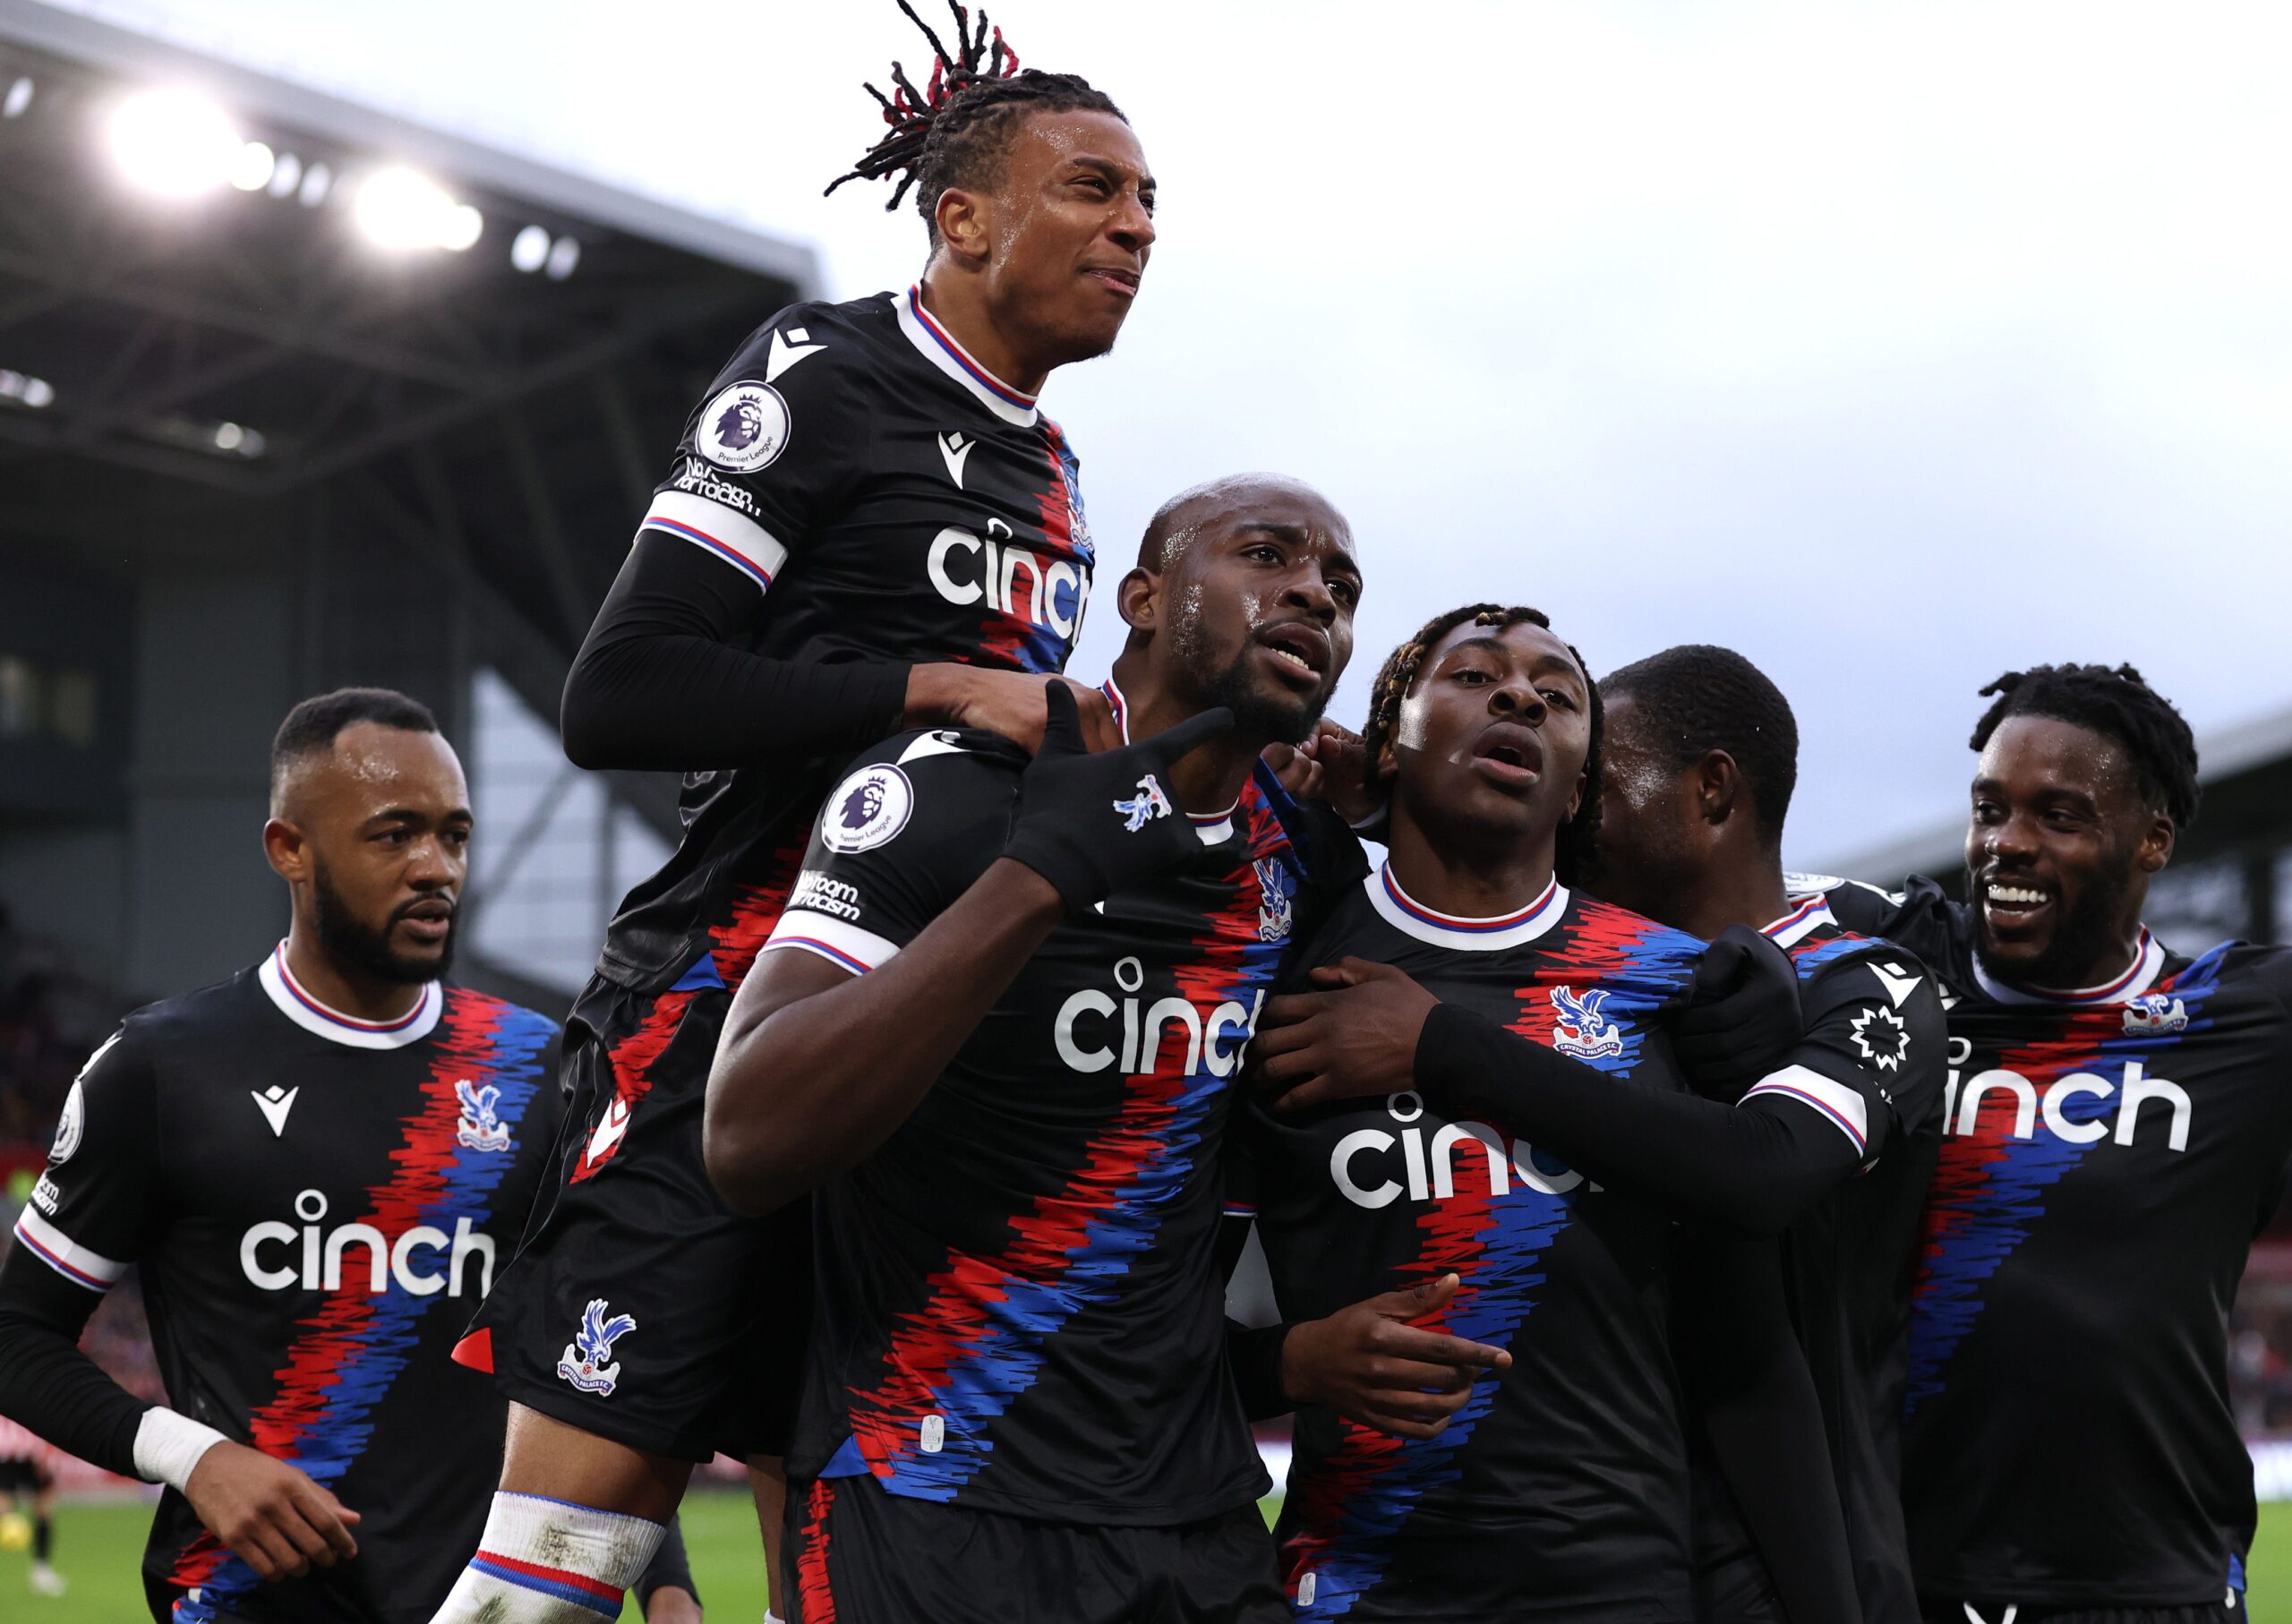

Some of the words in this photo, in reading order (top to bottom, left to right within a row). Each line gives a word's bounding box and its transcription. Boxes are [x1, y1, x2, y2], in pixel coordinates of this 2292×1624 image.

[718, 451, 748, 463] Premier
[749, 436, 774, 460] League
[865, 815, 892, 838] League
[1560, 1044, 1586, 1056] CRYSTAL
[1586, 1046, 1608, 1056] PALACE
[1942, 1036, 2192, 1153] inch
[1330, 1089, 1604, 1209] cinc
[240, 1188, 496, 1299] cinch
[560, 1364, 579, 1385] CRYSTAL
[579, 1380, 600, 1389] PALACE
